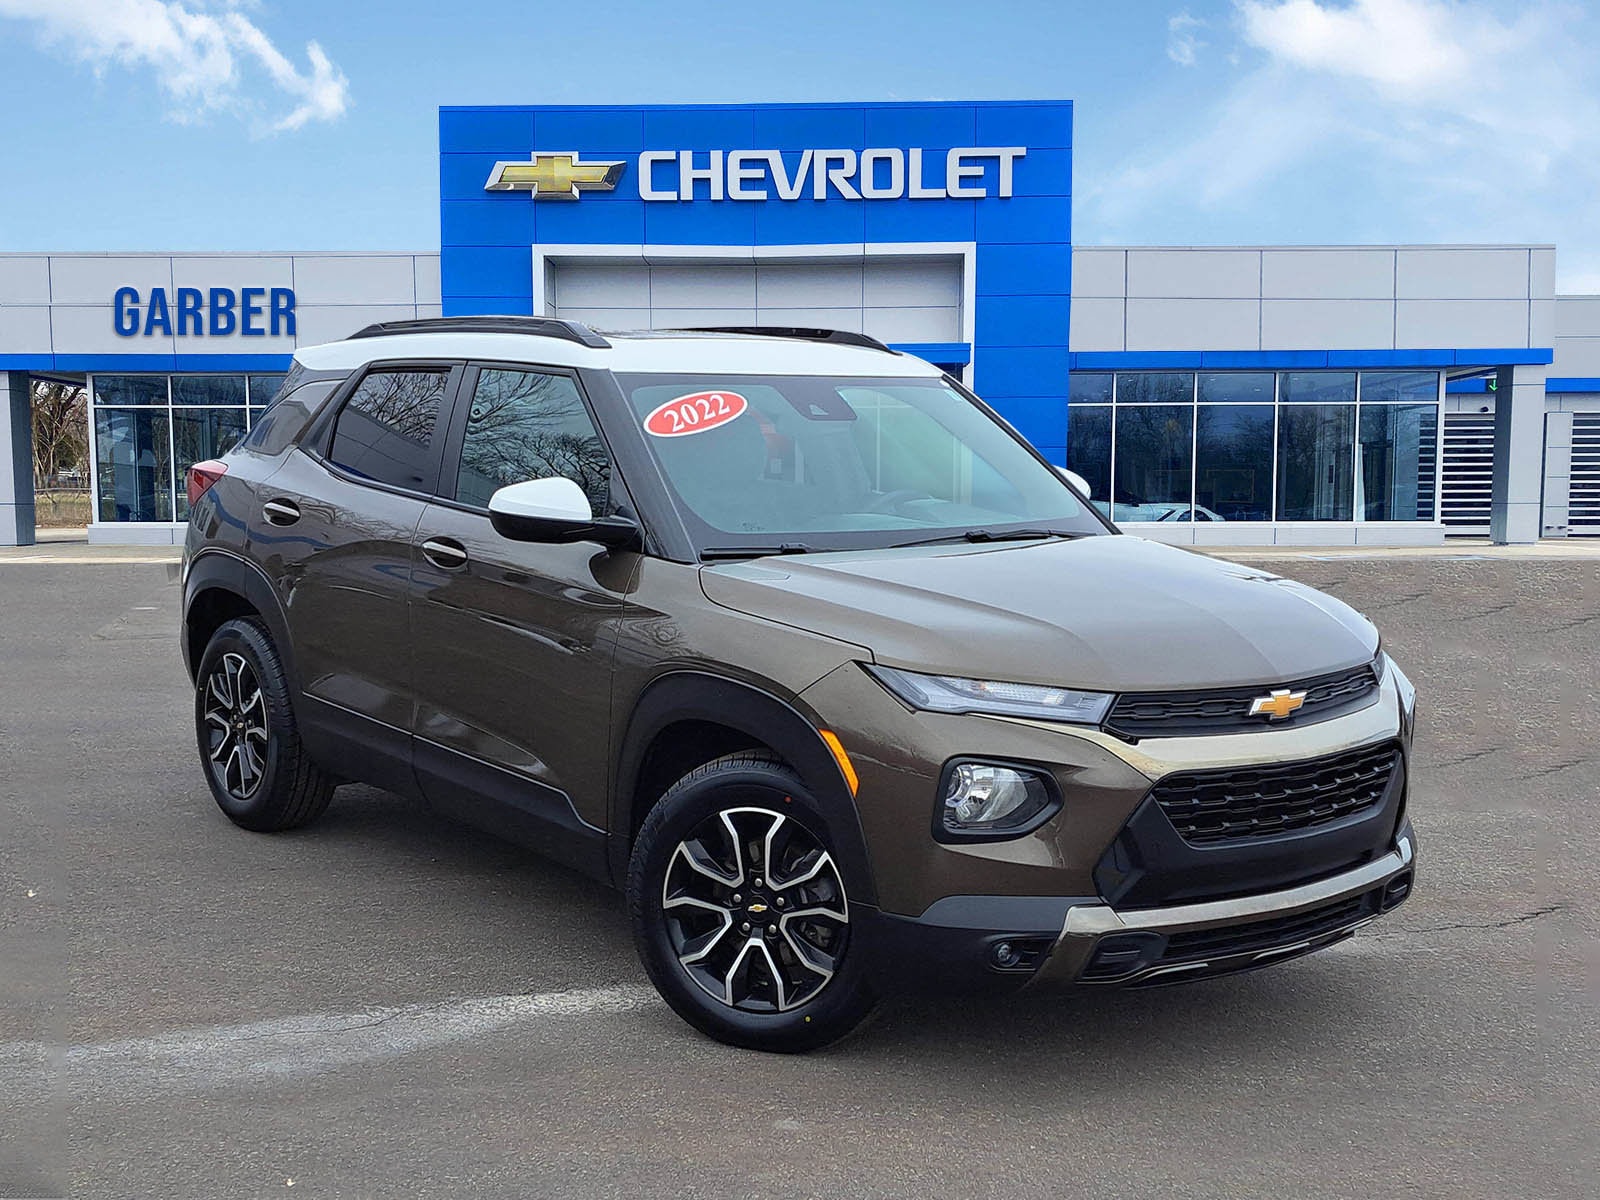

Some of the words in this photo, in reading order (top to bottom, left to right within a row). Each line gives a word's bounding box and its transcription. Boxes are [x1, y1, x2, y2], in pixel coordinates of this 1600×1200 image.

[638, 147, 1027, 200] CHEVROLET
[114, 287, 296, 336] GARBER
[664, 395, 730, 432] 2022
